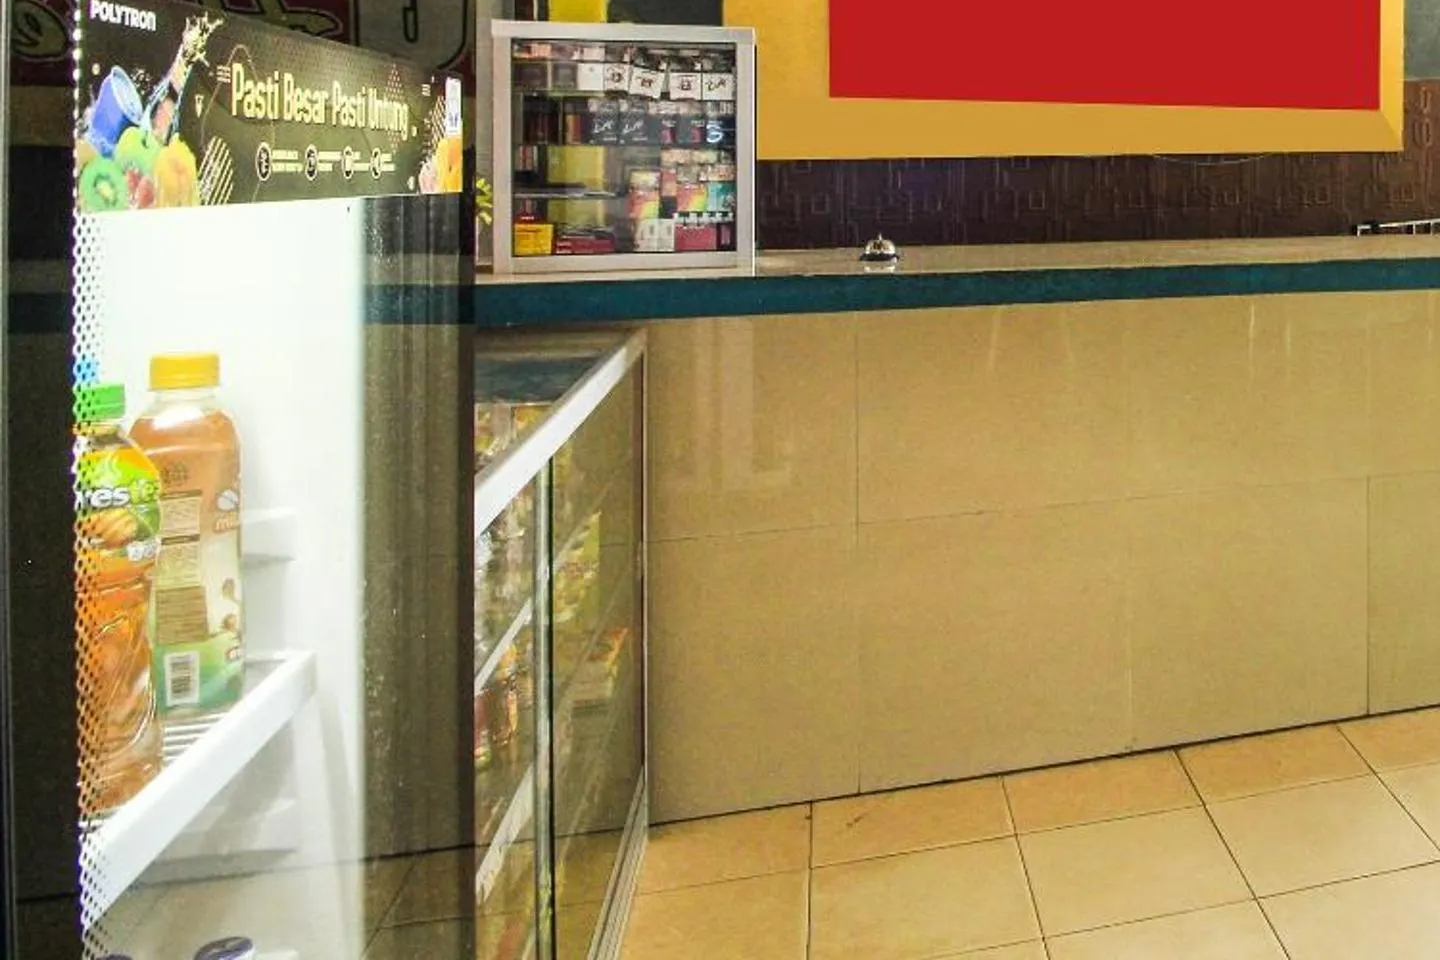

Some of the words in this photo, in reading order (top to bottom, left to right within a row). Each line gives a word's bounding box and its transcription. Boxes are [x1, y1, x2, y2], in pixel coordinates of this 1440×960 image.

[231, 62, 280, 120] Pasti
[283, 72, 328, 124] Besar
[331, 79, 366, 128] Pasti
[368, 86, 409, 141] Untung
